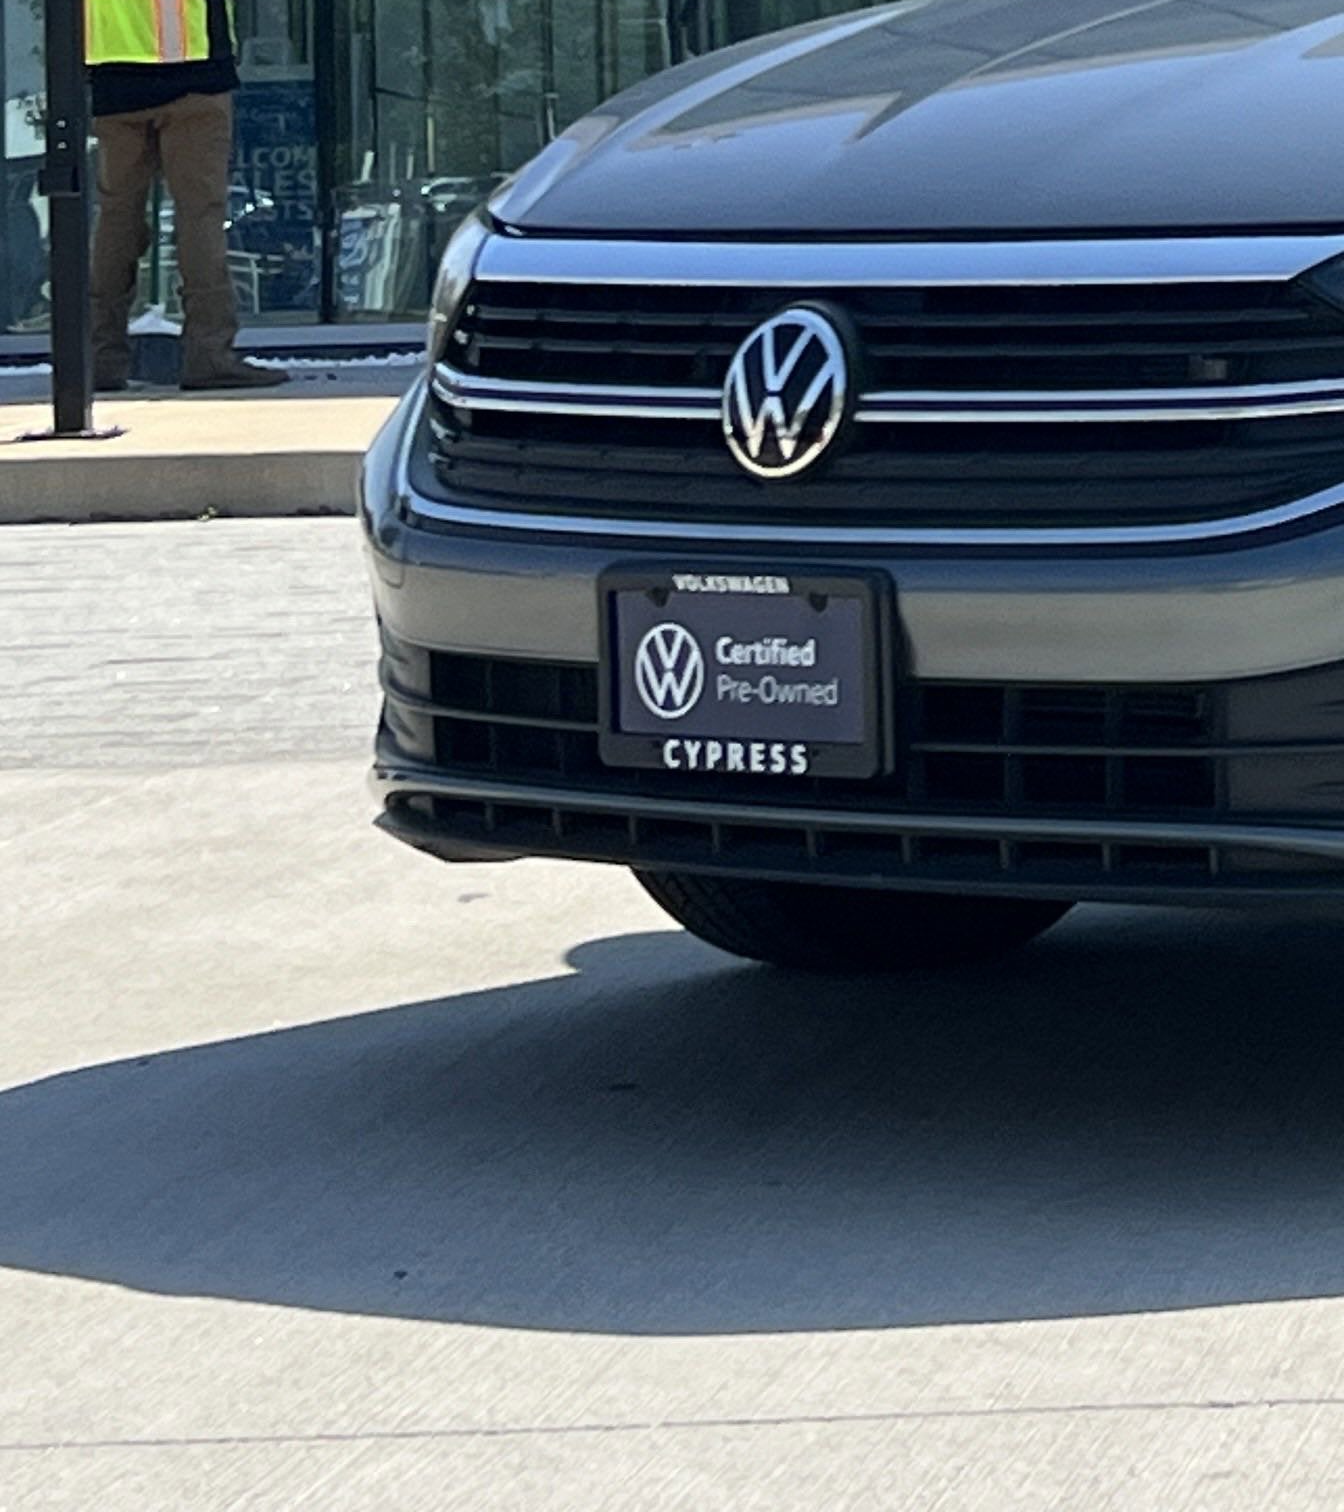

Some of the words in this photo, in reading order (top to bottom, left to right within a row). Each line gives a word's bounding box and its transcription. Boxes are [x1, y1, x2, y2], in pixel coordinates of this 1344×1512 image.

[722, 308, 846, 478] VW
[671, 573, 791, 595] VOLKSWAGEN
[715, 636, 817, 667] Certified
[635, 622, 705, 720] VW
[715, 673, 840, 706] Pre-Owned
[662, 738, 809, 776] CYPRESS
